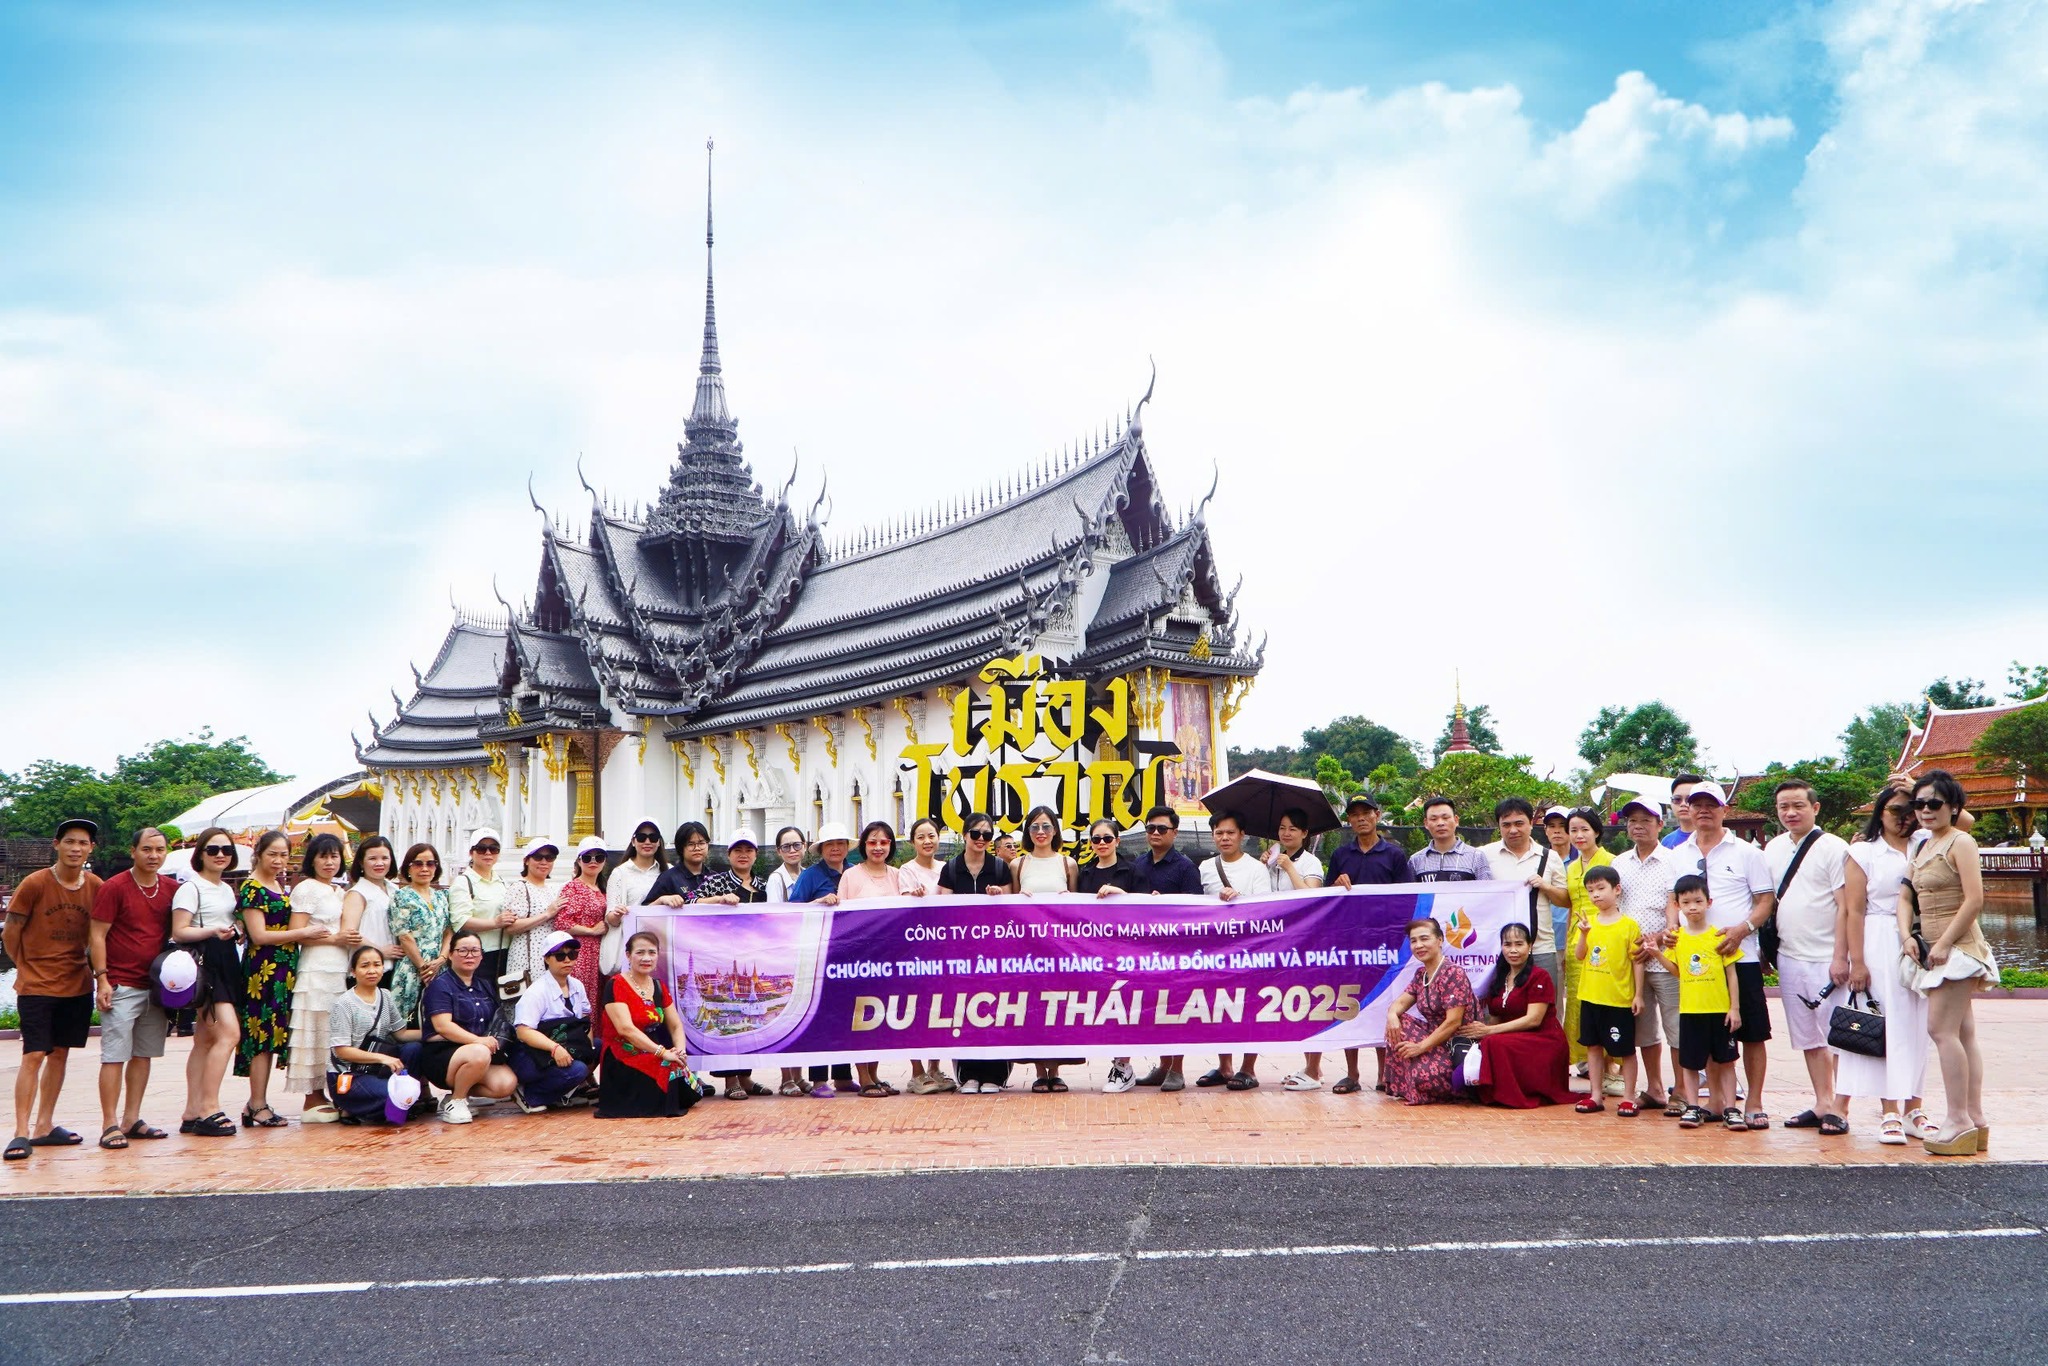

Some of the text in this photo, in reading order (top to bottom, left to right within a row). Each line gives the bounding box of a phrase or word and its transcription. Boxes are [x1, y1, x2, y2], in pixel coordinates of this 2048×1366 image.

[952, 654, 1129, 757] เมือง
[904, 918, 1284, 941] CÔNG TY CP ĐẦU TƯ THƯƠNG MẠI XNK THT VIỆT NAM
[825, 959, 893, 979] CHƯƠNG
[896, 956, 943, 977] TRÌNH
[946, 959, 971, 975] TRI
[974, 954, 998, 974] ÂN
[1001, 953, 1055, 973] KHÁCH
[1058, 953, 1104, 973] HÀNG
[1116, 956, 1136, 972] 20
[1139, 952, 1176, 972] NĂM
[1179, 949, 1226, 971] ĐỒNG
[1229, 948, 1276, 969] HÀNH
[1279, 948, 1303, 968] VÀ
[1305, 946, 1348, 967] PHÁT
[1351, 943, 1399, 966] TRIỂN
[851, 979, 1361, 1038] DU LỊCH THÁI LAN 2025
